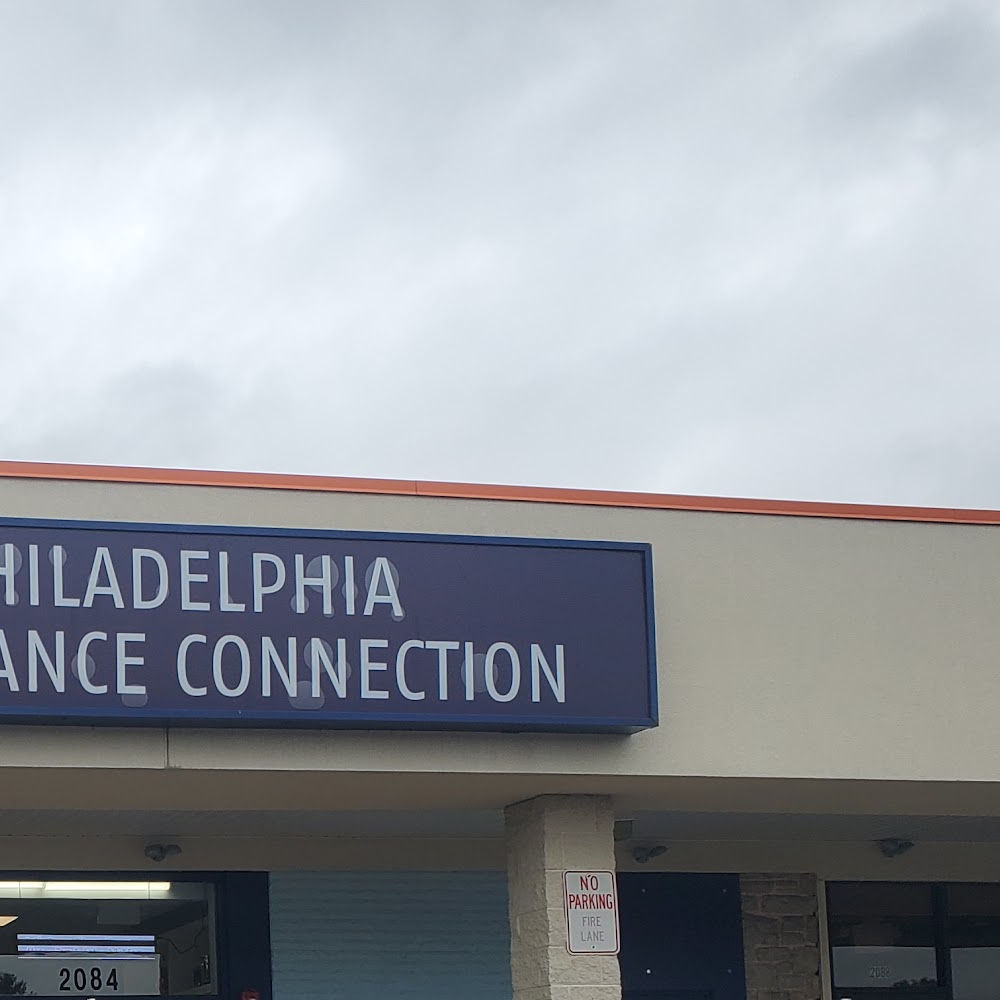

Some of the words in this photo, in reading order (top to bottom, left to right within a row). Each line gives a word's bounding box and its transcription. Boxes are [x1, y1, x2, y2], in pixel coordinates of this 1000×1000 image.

[176, 633, 566, 703] CONNECTION
[579, 875, 599, 891] NO
[568, 893, 613, 910] PARKING
[582, 916, 602, 927] FIRE
[580, 930, 605, 942] LANE
[59, 967, 118, 991] 2084
